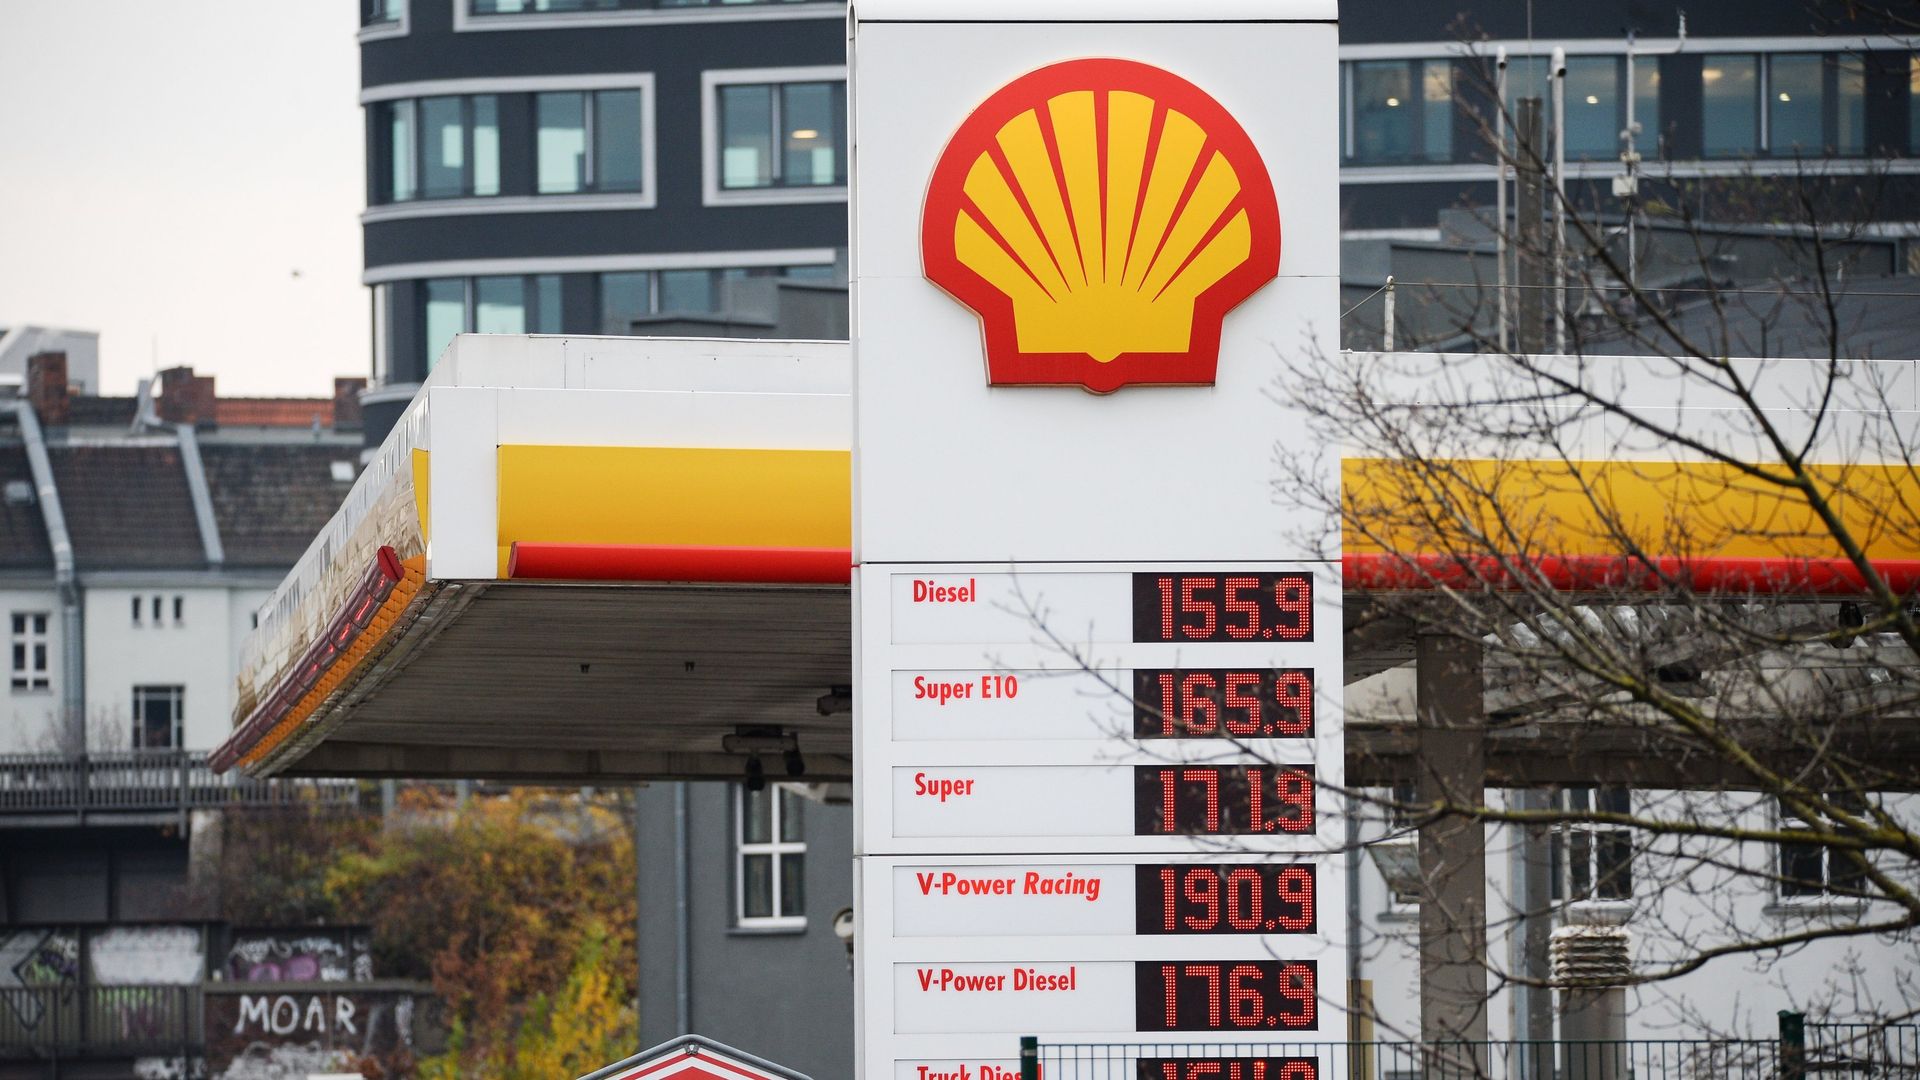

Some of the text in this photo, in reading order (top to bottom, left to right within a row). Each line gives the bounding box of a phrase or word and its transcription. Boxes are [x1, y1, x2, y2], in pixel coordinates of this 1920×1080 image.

[914, 578, 975, 602] Diesel
[1158, 577, 1310, 639] 155.9
[914, 675, 1018, 705] Super E10
[1159, 672, 1311, 735] 165.9
[915, 772, 974, 802] Super
[1160, 769, 1312, 832] 171.9
[917, 872, 1100, 902] V-Power Racing
[1161, 868, 1312, 930] 190.9
[918, 967, 1075, 992] V-Power Diesel
[1162, 965, 1314, 1026] 176.9
